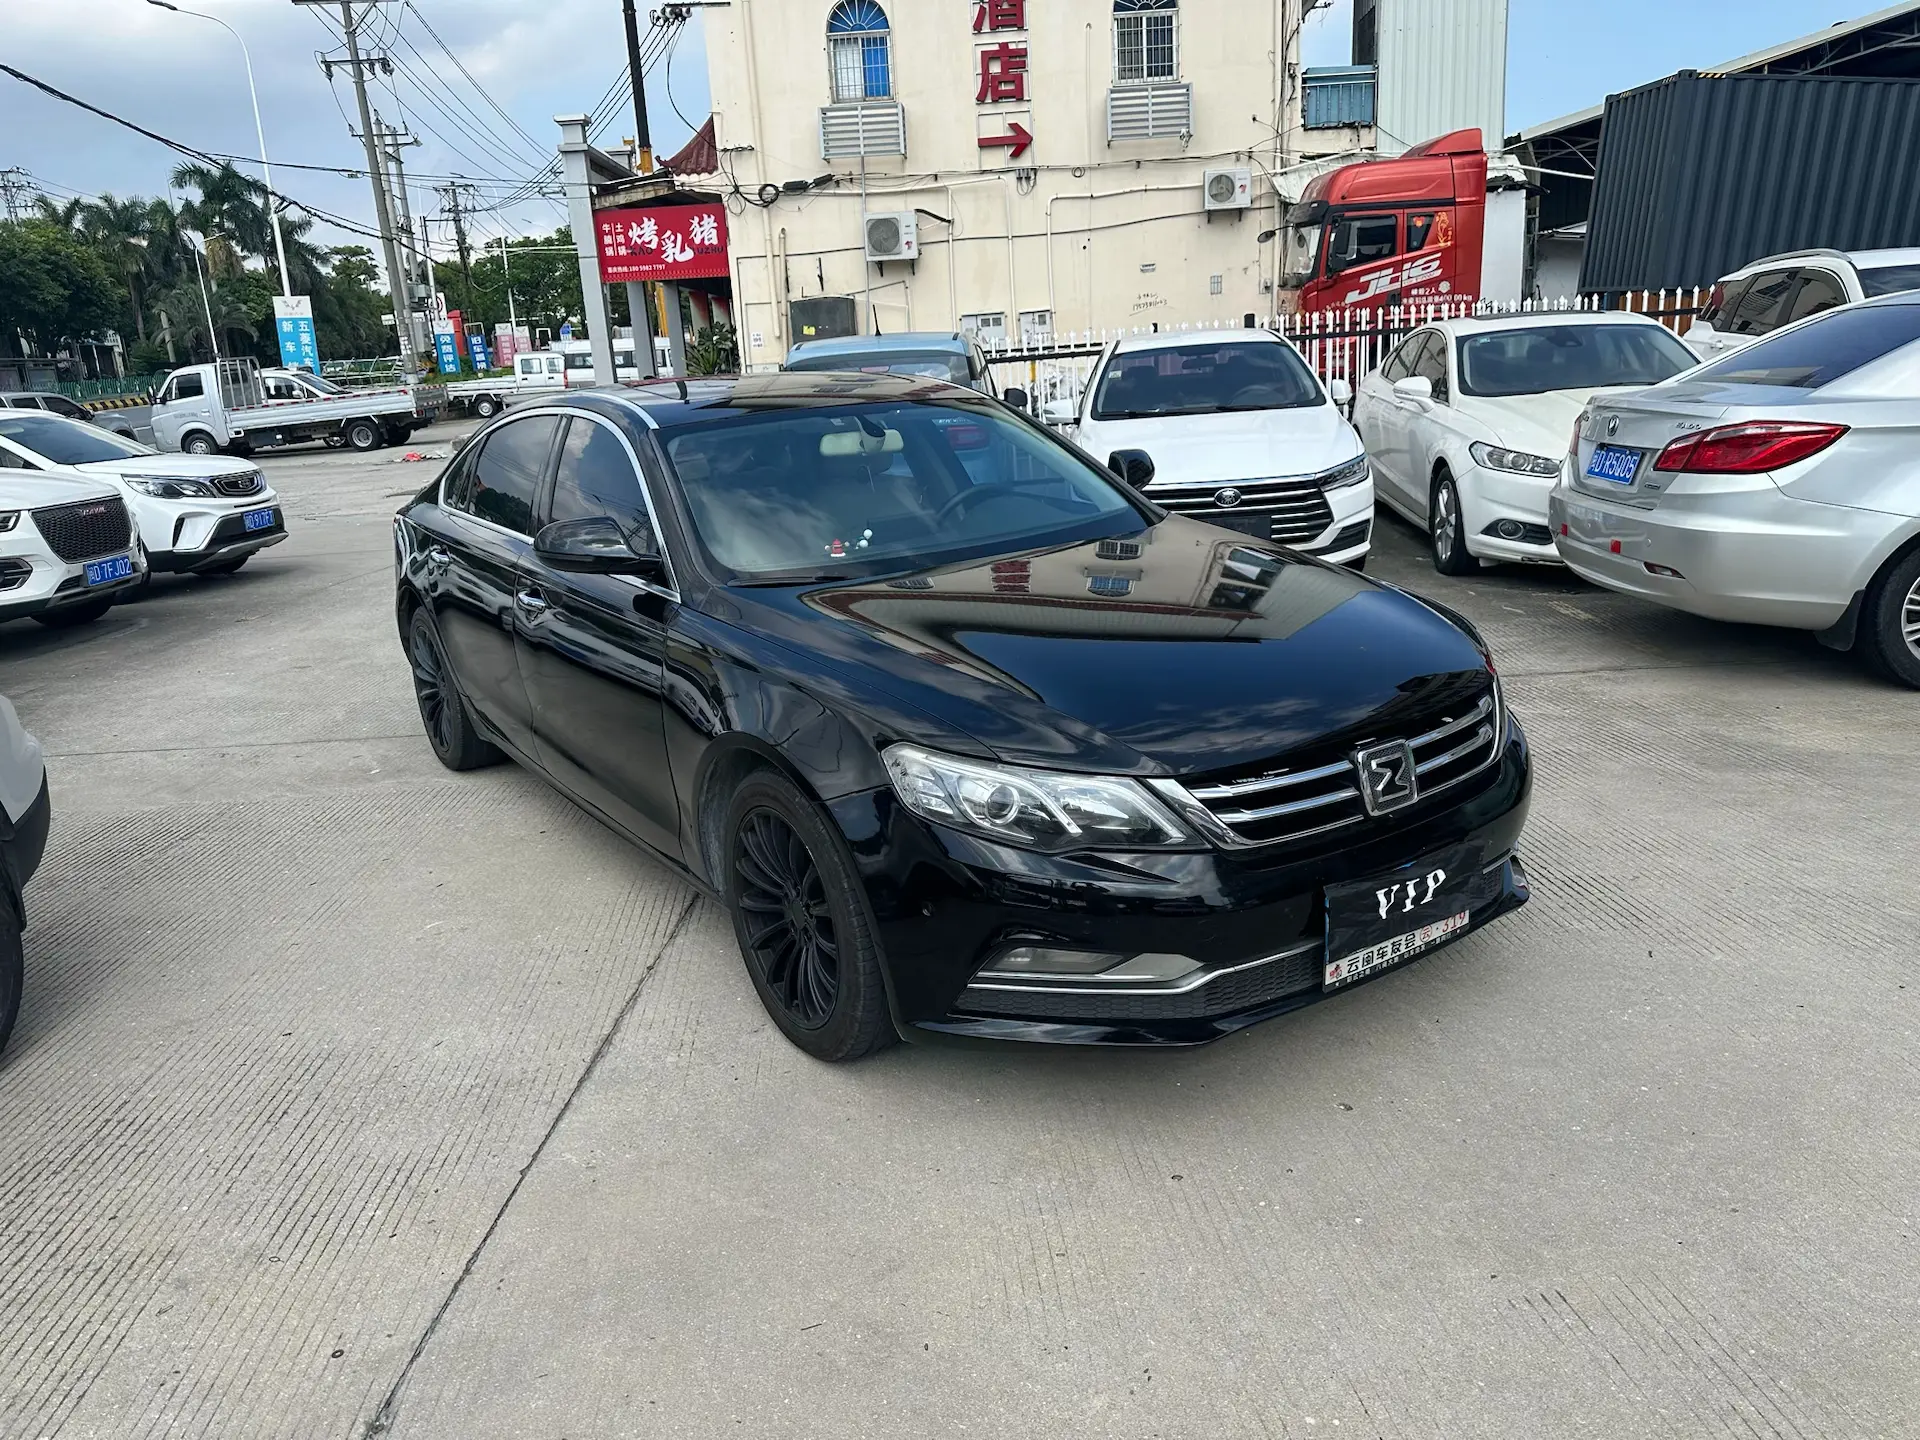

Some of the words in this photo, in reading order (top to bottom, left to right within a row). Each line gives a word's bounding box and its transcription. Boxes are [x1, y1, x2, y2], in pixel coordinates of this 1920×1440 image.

[615, 223, 627, 256] 土鸡锅
[628, 214, 718, 263] 烤乳猪
[690, 246, 724, 256] UZHU
[297, 320, 314, 367] 五菱汽车
[440, 335, 456, 372] 免费评估
[471, 337, 487, 369] 旧车置换
[1375, 868, 1447, 920] VIP
[1347, 932, 1416, 974] 云闽车友会
